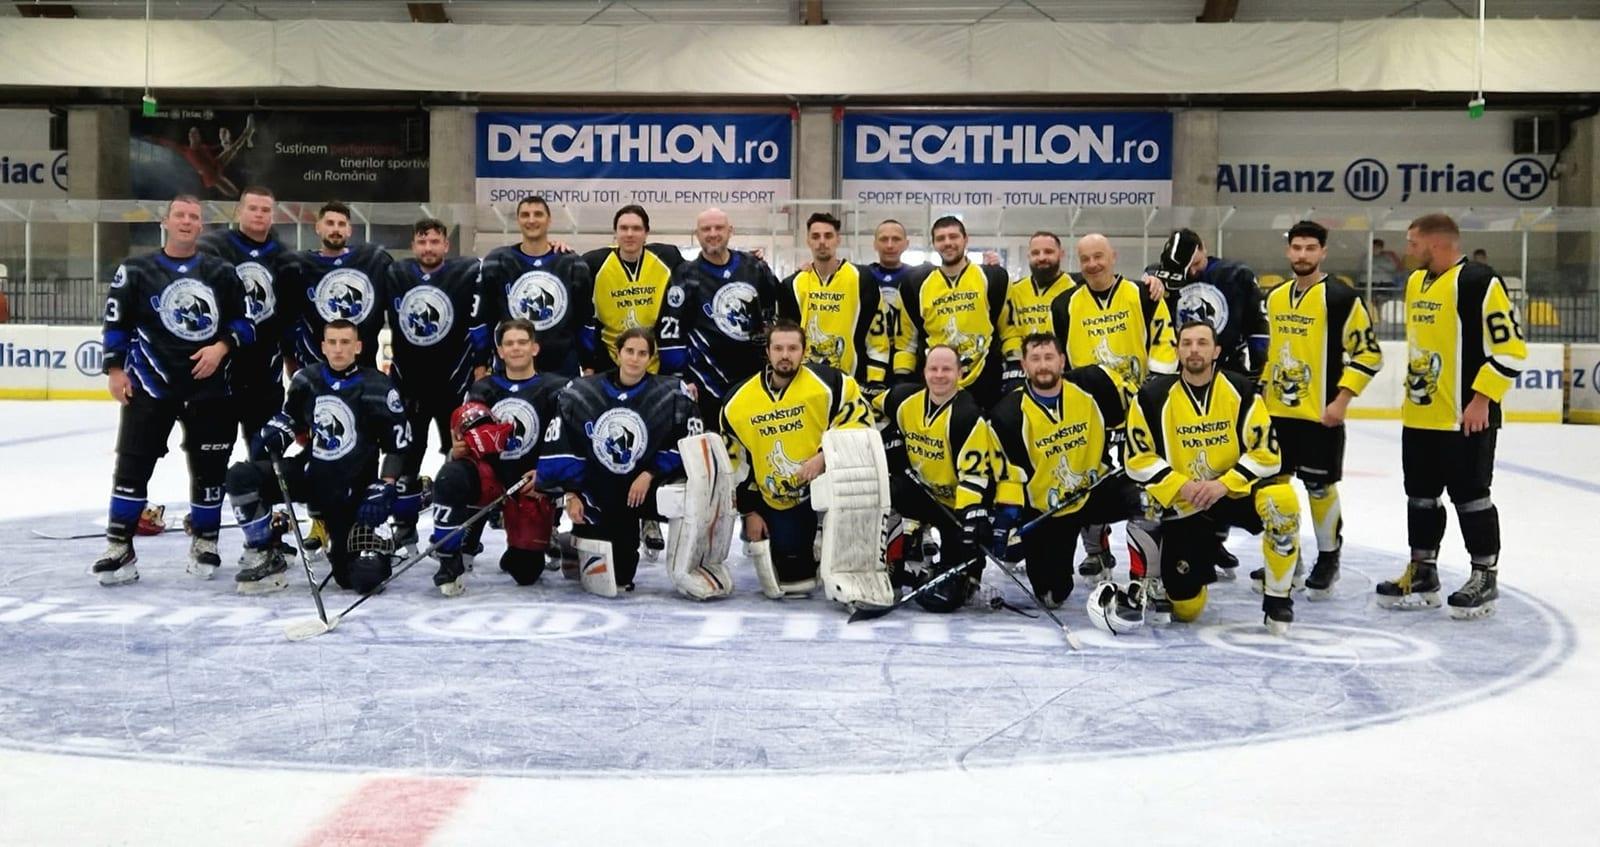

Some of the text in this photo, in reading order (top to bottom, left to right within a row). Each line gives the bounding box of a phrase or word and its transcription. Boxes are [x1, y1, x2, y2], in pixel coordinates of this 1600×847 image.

[275, 142, 328, 155] Susținem
[488, 124, 779, 163] DECATHLON.ro
[856, 125, 1160, 164] DECATHLON.ro
[0, 156, 44, 184] iac
[340, 157, 385, 168] tinerilor
[303, 169, 377, 181] din România
[1216, 163, 1494, 202] Allianz Țiriac
[490, 189, 534, 202] SPORT
[536, 190, 590, 203] PENTRU
[630, 189, 673, 203] TOTUL
[675, 190, 729, 204] PENTRU
[731, 190, 775, 204] SPORT
[858, 191, 903, 205] SPORT
[905, 191, 961, 205] PENTRU
[1004, 191, 1047, 205] TOTUL
[1050, 191, 1107, 205] PENTRU
[1109, 191, 1156, 205] SPORT
[611, 286, 656, 298] KRONSTADT
[931, 290, 980, 307] KRONSTADT
[616, 297, 654, 308] PUB BOYS
[820, 303, 841, 313] BOYS
[955, 302, 976, 314] BOYS
[660, 316, 681, 339] 27
[1082, 310, 1130, 328] KRONSTADT
[1348, 328, 1381, 356] 28
[750, 405, 806, 426] KRONSTADT
[393, 419, 413, 449] 24
[759, 419, 804, 437] PUB BOYS
[1035, 421, 1089, 448] KRONSTADT
[1176, 420, 1231, 434] KRONSTADT
[1045, 435, 1088, 459] PUB BOYS
[1182, 434, 1230, 448] PUB BOYS
[203, 486, 220, 502] 13
[432, 502, 452, 523] 77
